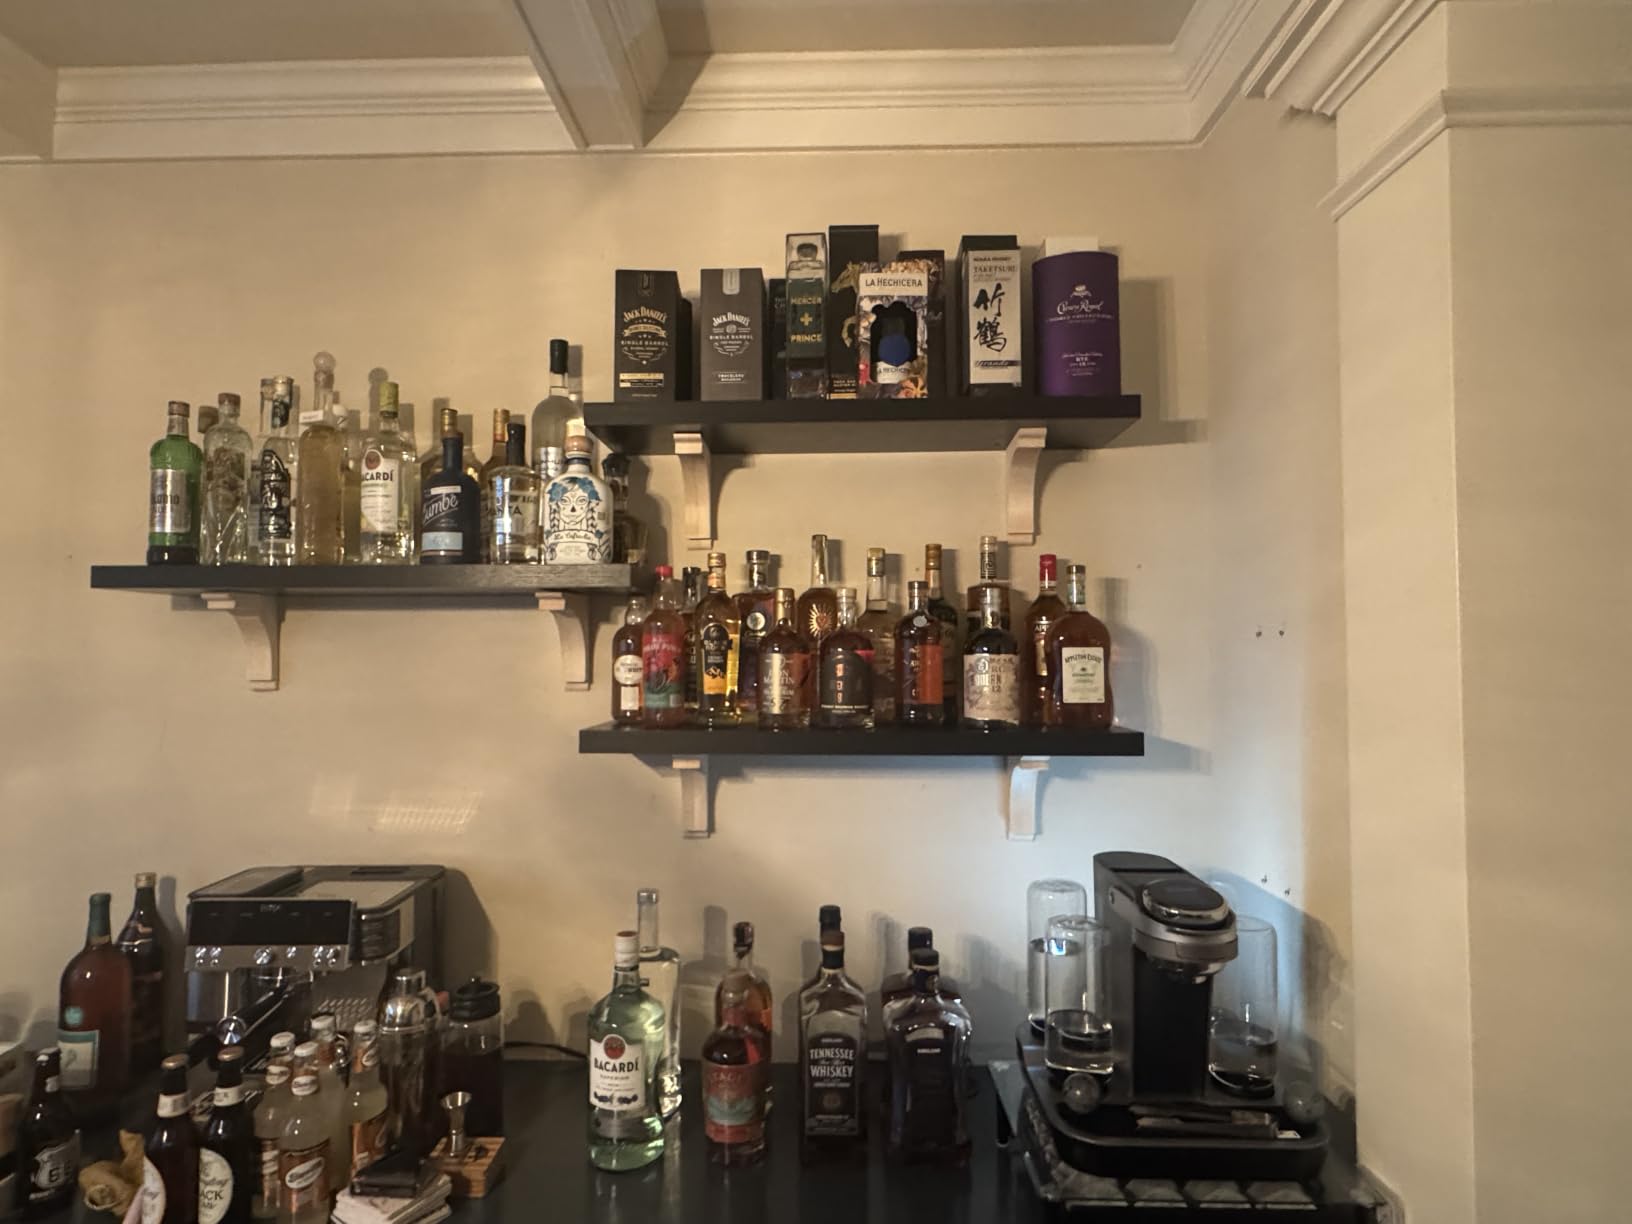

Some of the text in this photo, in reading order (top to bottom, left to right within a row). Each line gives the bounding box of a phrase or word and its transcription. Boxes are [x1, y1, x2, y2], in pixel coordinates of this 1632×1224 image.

[865, 276, 923, 288] LA HECHICERA
[790, 296, 822, 305] MERCER
[623, 309, 641, 323] JACK
[712, 314, 727, 327] JACK
[790, 333, 822, 343] PRINCE
[809, 1047, 855, 1061] TENNESSEE
[594, 1055, 641, 1073] BACARDÍ
[810, 1064, 855, 1078] WHISKEY
